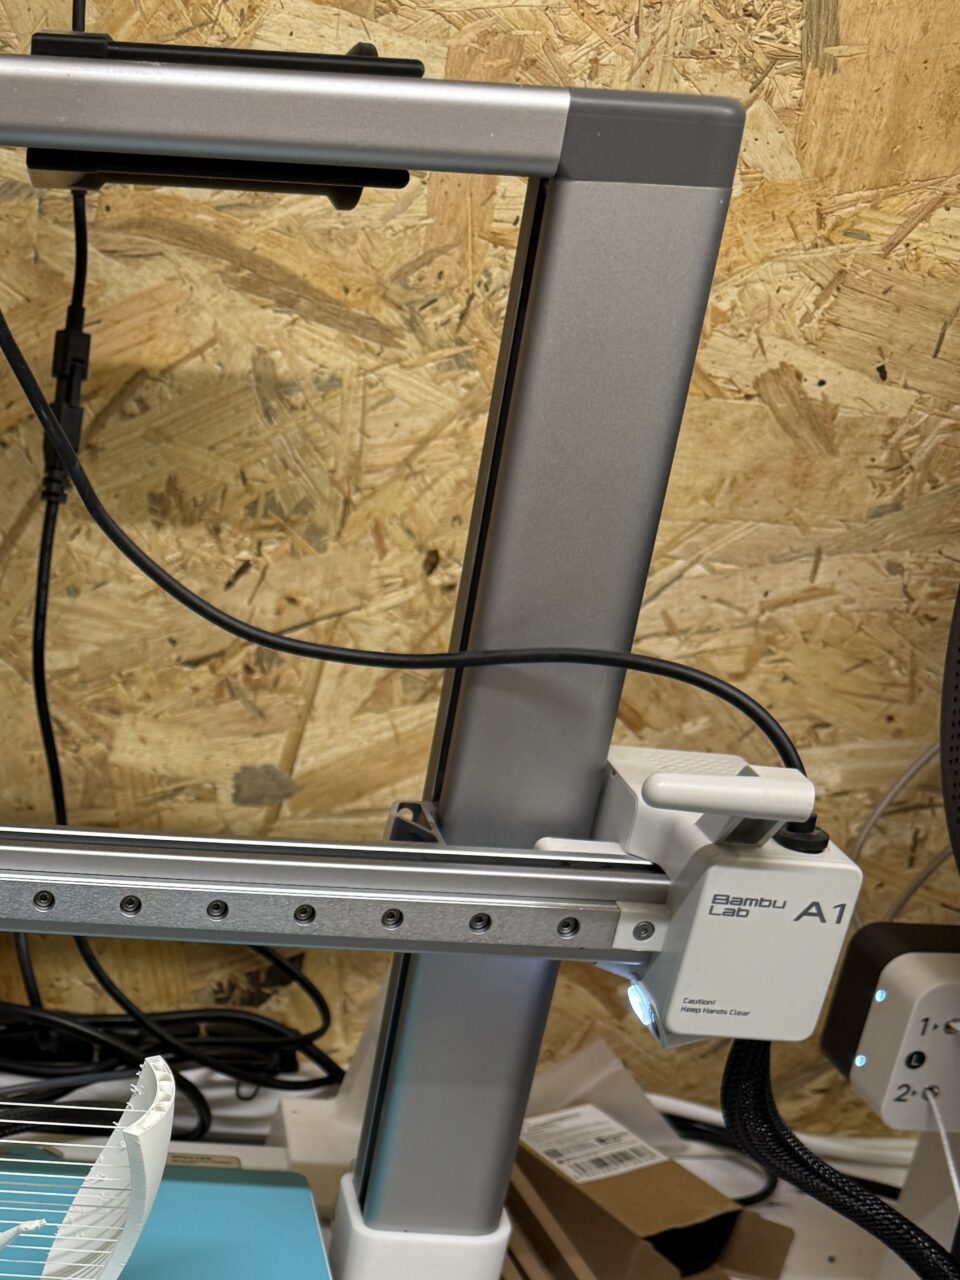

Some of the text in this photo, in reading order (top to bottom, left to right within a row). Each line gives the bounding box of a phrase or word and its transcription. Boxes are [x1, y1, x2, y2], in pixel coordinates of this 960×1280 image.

[708, 893, 787, 918] Bambu Lab
[793, 901, 847, 924] A1
[682, 997, 717, 1006] Caution!
[680, 1006, 751, 1017] Keep Hands Clear
[920, 1017, 930, 1036] 1
[893, 1083, 911, 1102] 2
